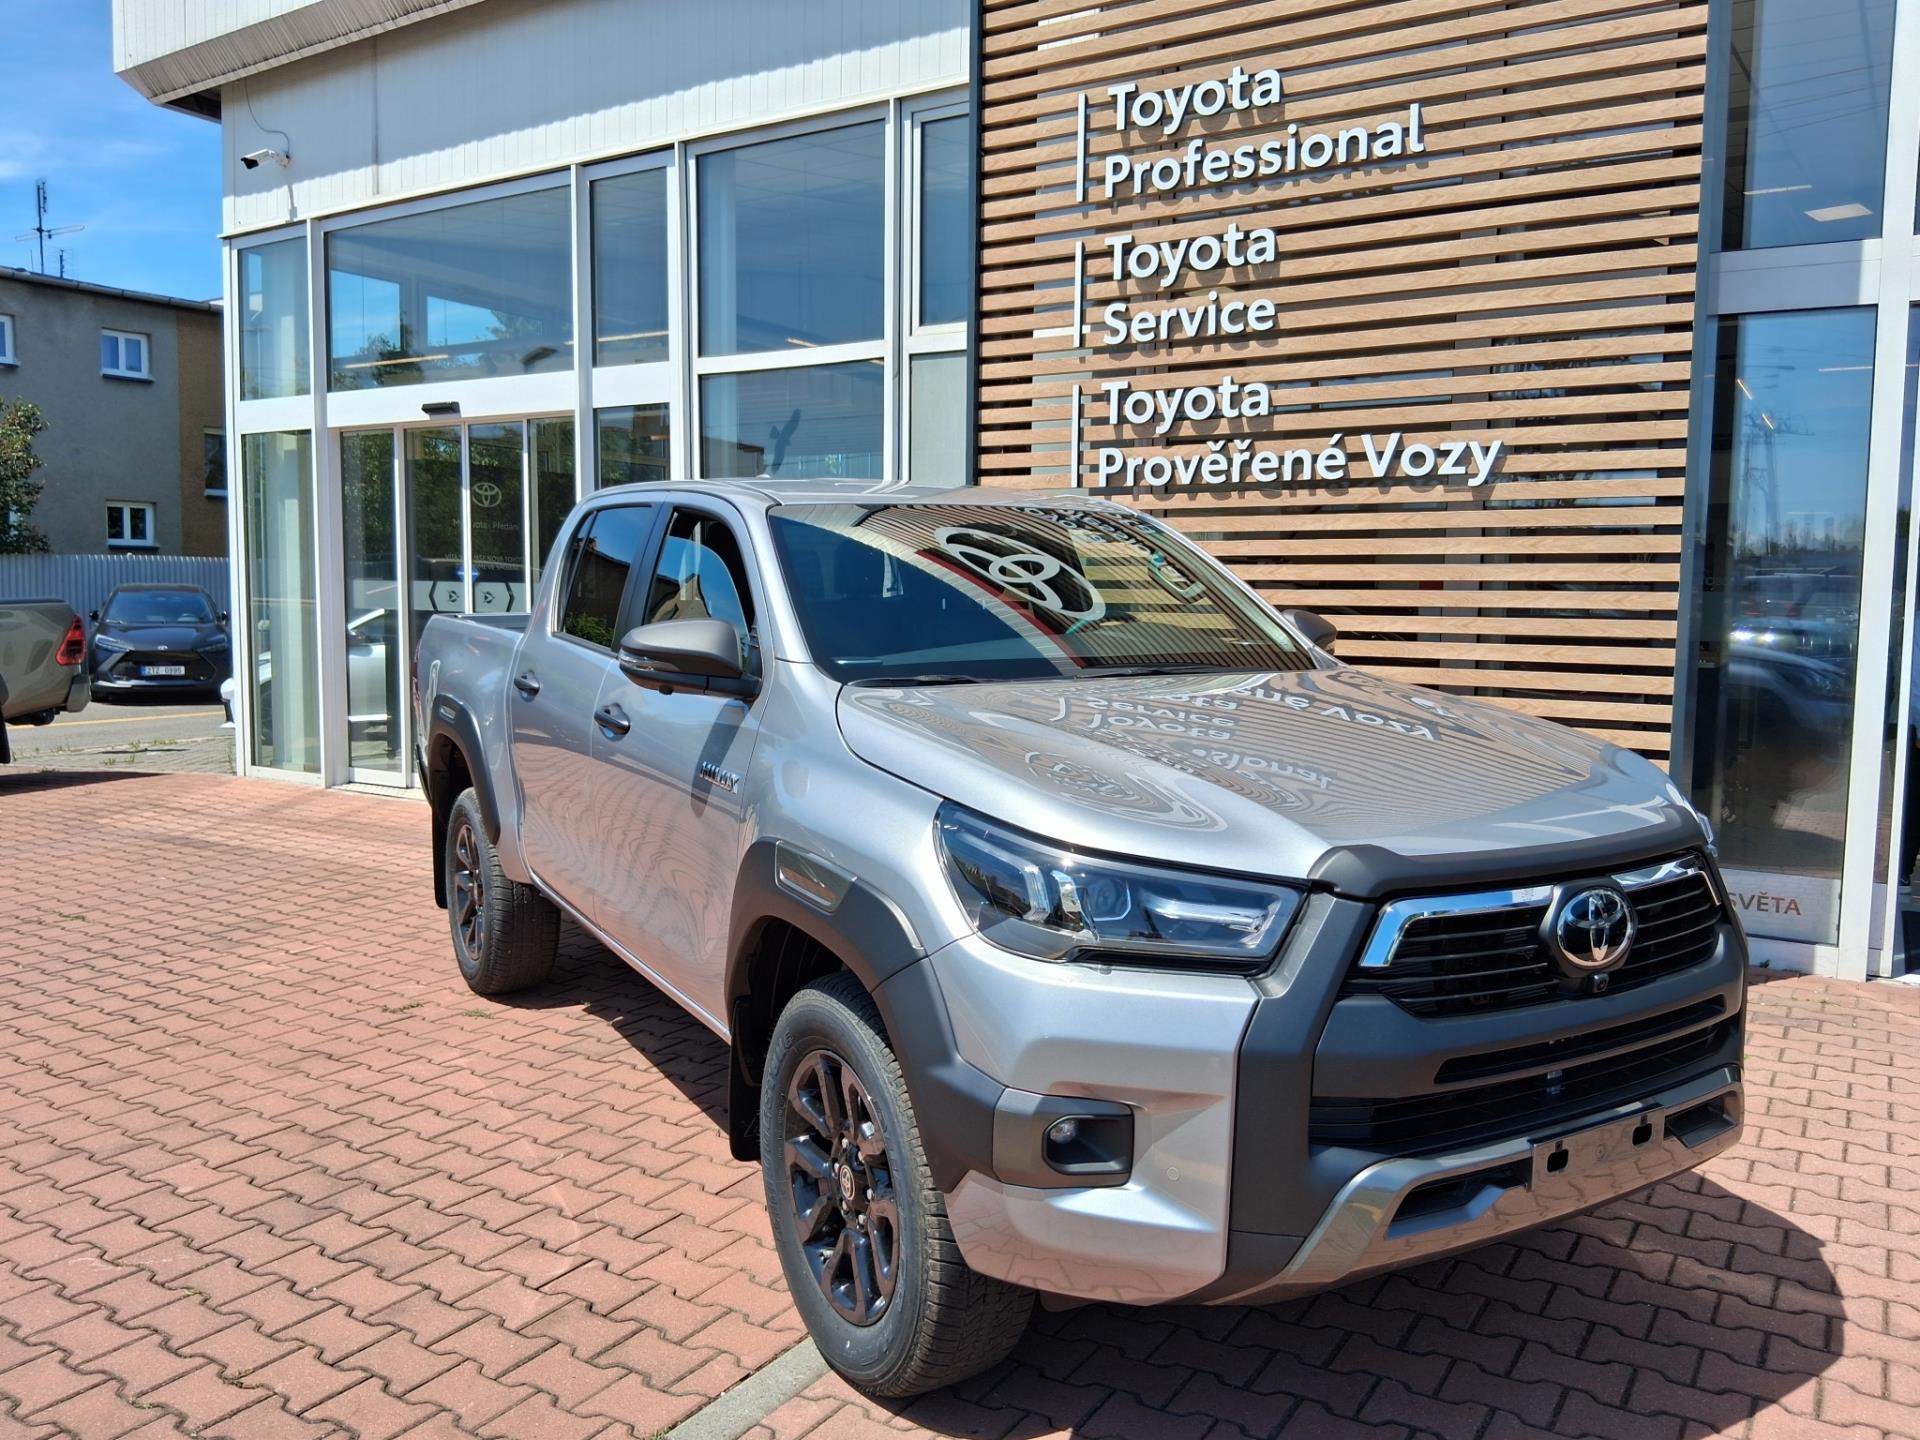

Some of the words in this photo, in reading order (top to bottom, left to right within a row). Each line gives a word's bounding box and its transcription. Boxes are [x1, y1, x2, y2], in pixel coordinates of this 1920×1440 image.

[1108, 66, 1282, 135] Toyota
[1104, 103, 1425, 199] Professional
[1104, 223, 1277, 288] Toyota
[1103, 291, 1277, 345] Service
[1101, 376, 1270, 434] Toyota
[1099, 433, 1346, 487] Prověřené
[1361, 432, 1502, 487] Vozy
